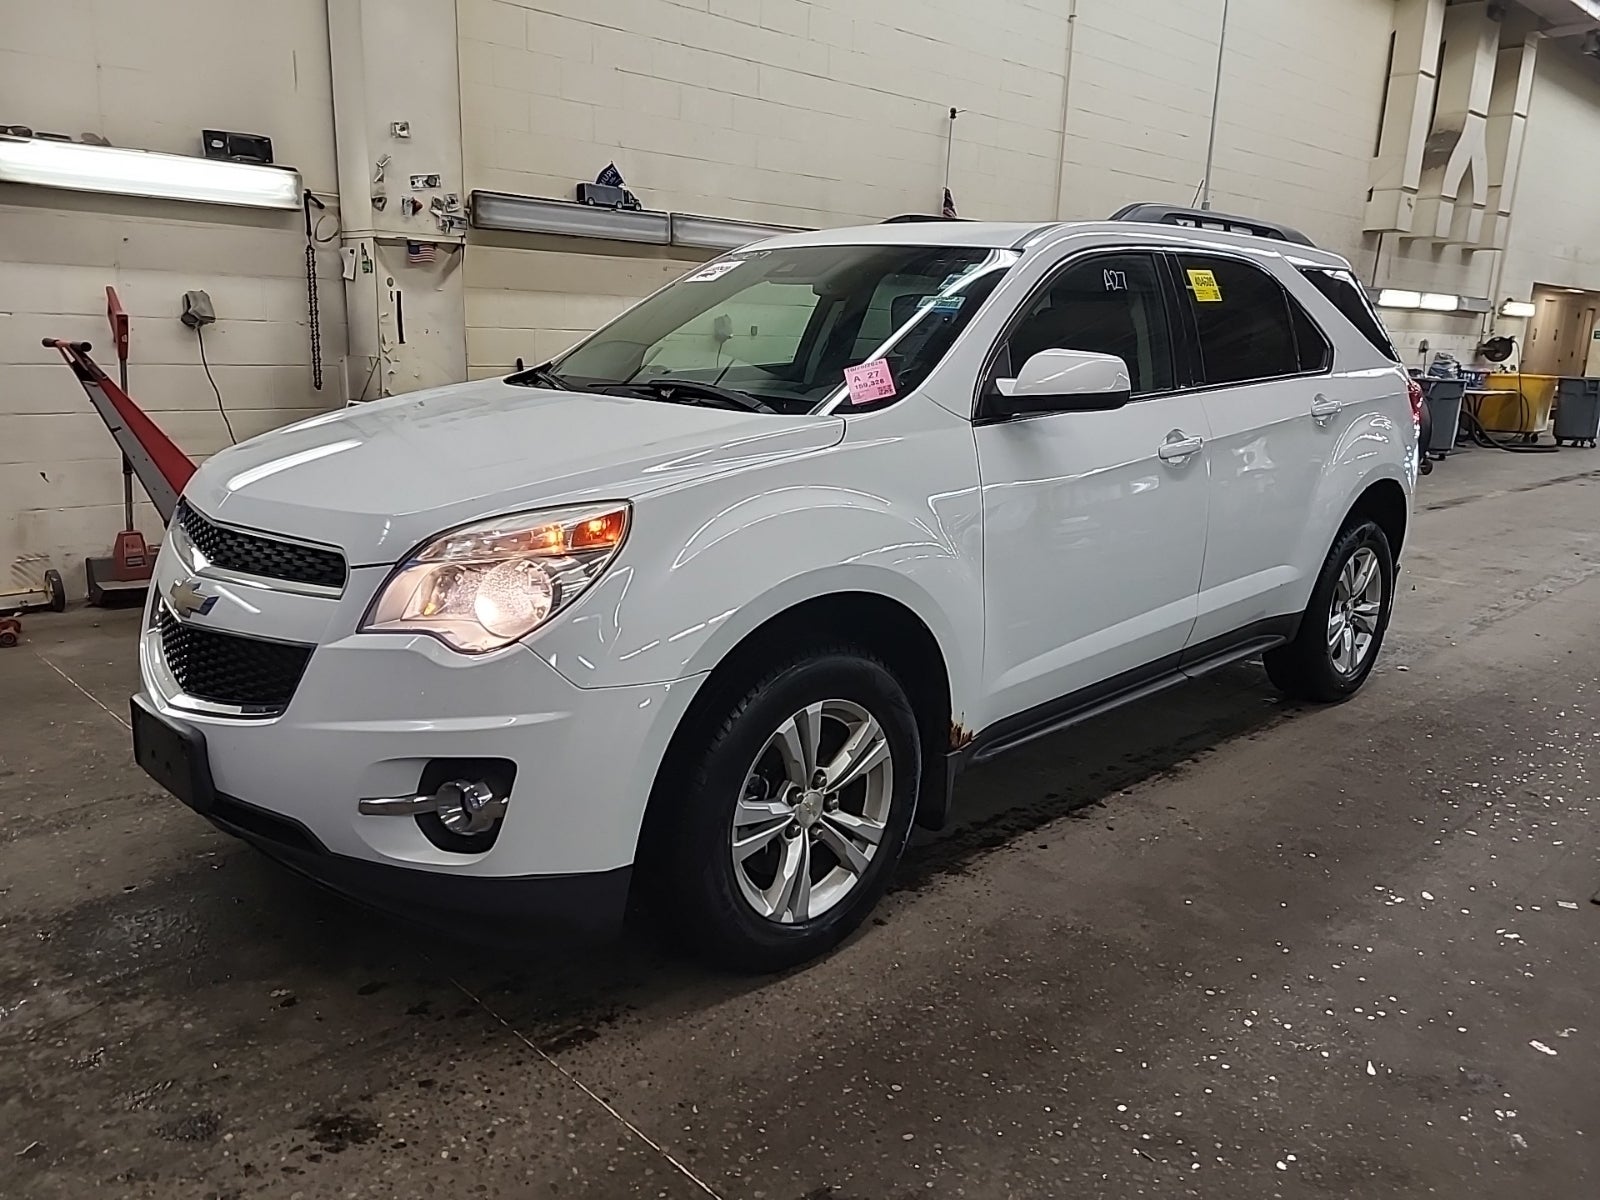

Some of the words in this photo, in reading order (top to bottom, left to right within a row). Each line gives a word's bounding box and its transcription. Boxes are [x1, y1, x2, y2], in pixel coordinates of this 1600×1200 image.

[1103, 268, 1128, 290] A27
[853, 375, 861, 383] A
[867, 370, 879, 379] 27
